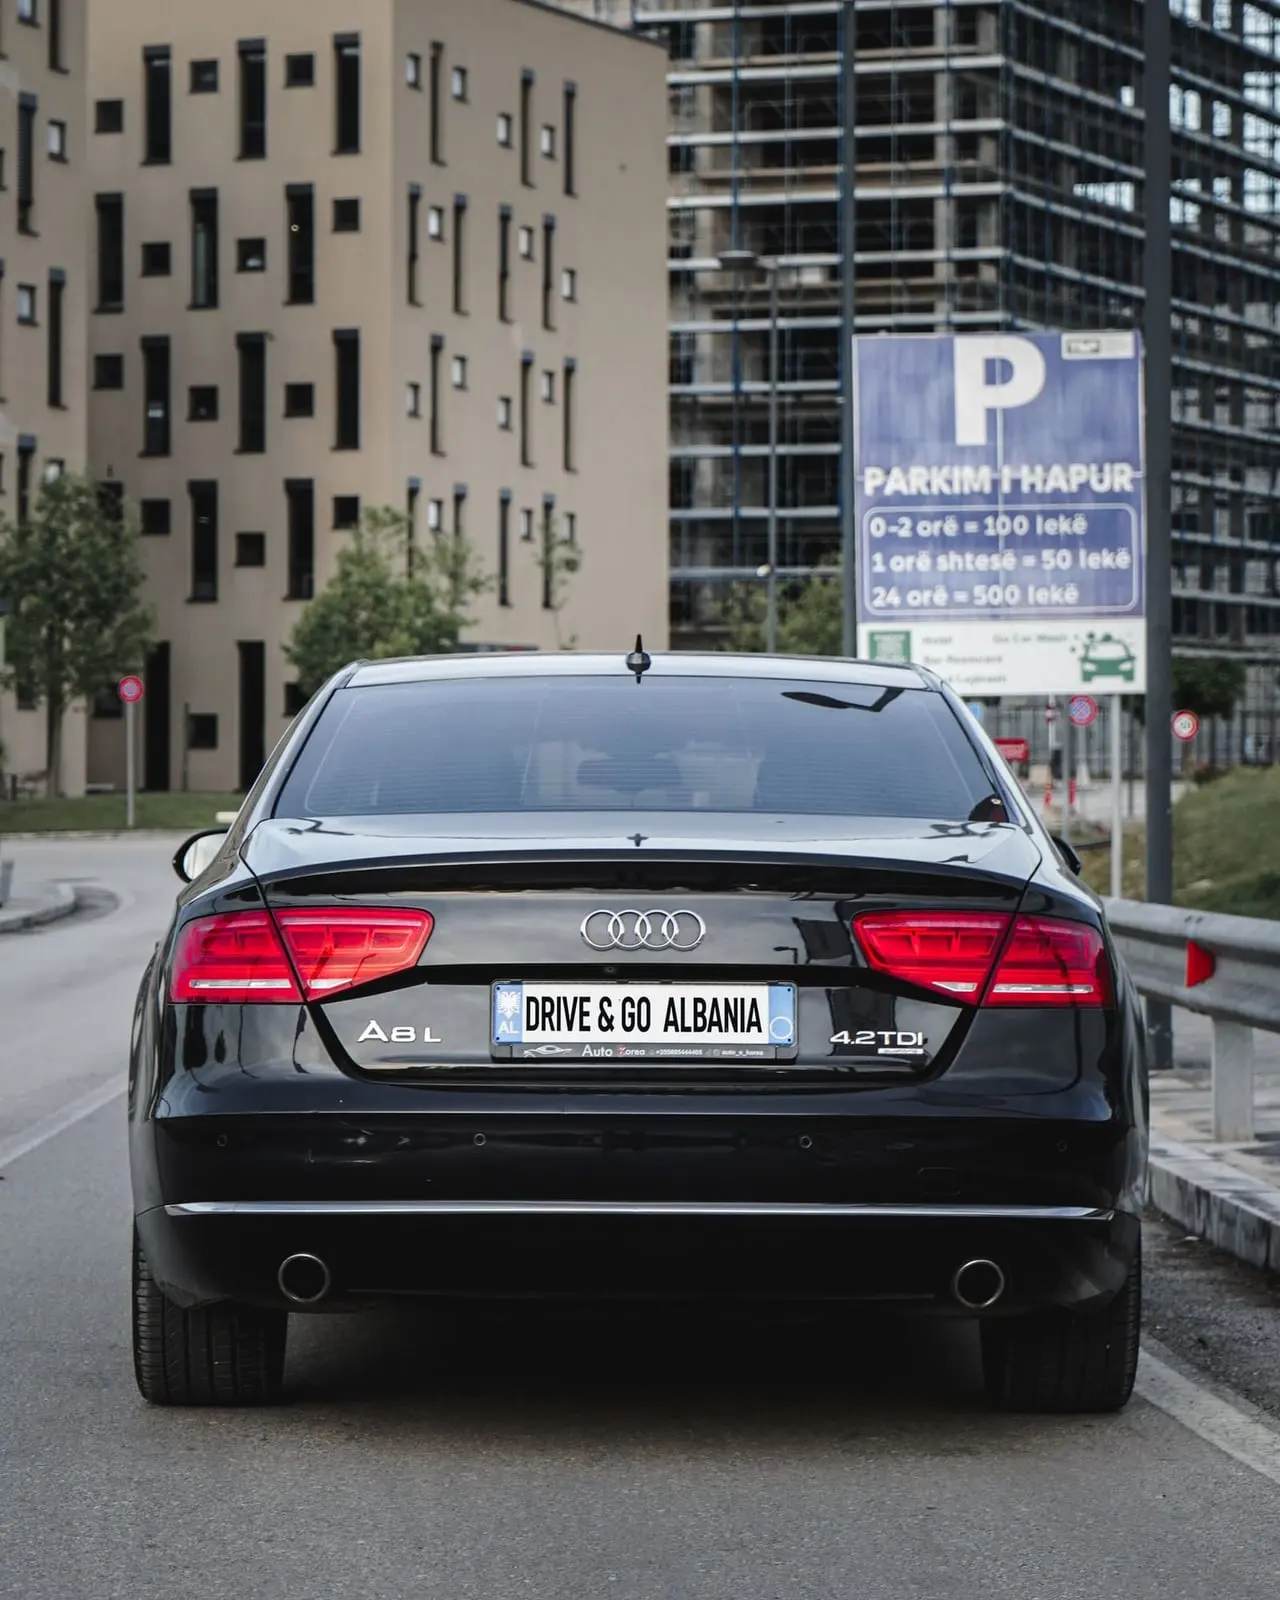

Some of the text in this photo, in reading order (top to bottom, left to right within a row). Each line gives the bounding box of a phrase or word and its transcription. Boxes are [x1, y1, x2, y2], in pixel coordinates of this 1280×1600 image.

[954, 336, 1046, 446] P
[863, 462, 1134, 496] PARKIM I HAPUR
[869, 515, 913, 538] 0-2
[916, 514, 960, 537] orë
[983, 514, 1029, 537] 100
[1036, 513, 1088, 536] lekë
[871, 551, 887, 573] 1
[889, 551, 932, 572] orë
[936, 550, 1017, 573] shtesë
[1041, 548, 1073, 571] 50
[1078, 547, 1131, 571] lekë
[871, 586, 902, 608] 24
[906, 585, 949, 607] orë
[972, 584, 1021, 606] 500
[1027, 583, 1079, 606] lekë
[526, 996, 763, 1033] DRIVE & GO ALBANIA
[357, 1019, 442, 1043] A8 L
[498, 1021, 519, 1034] AL
[581, 1043, 614, 1057] Auto
